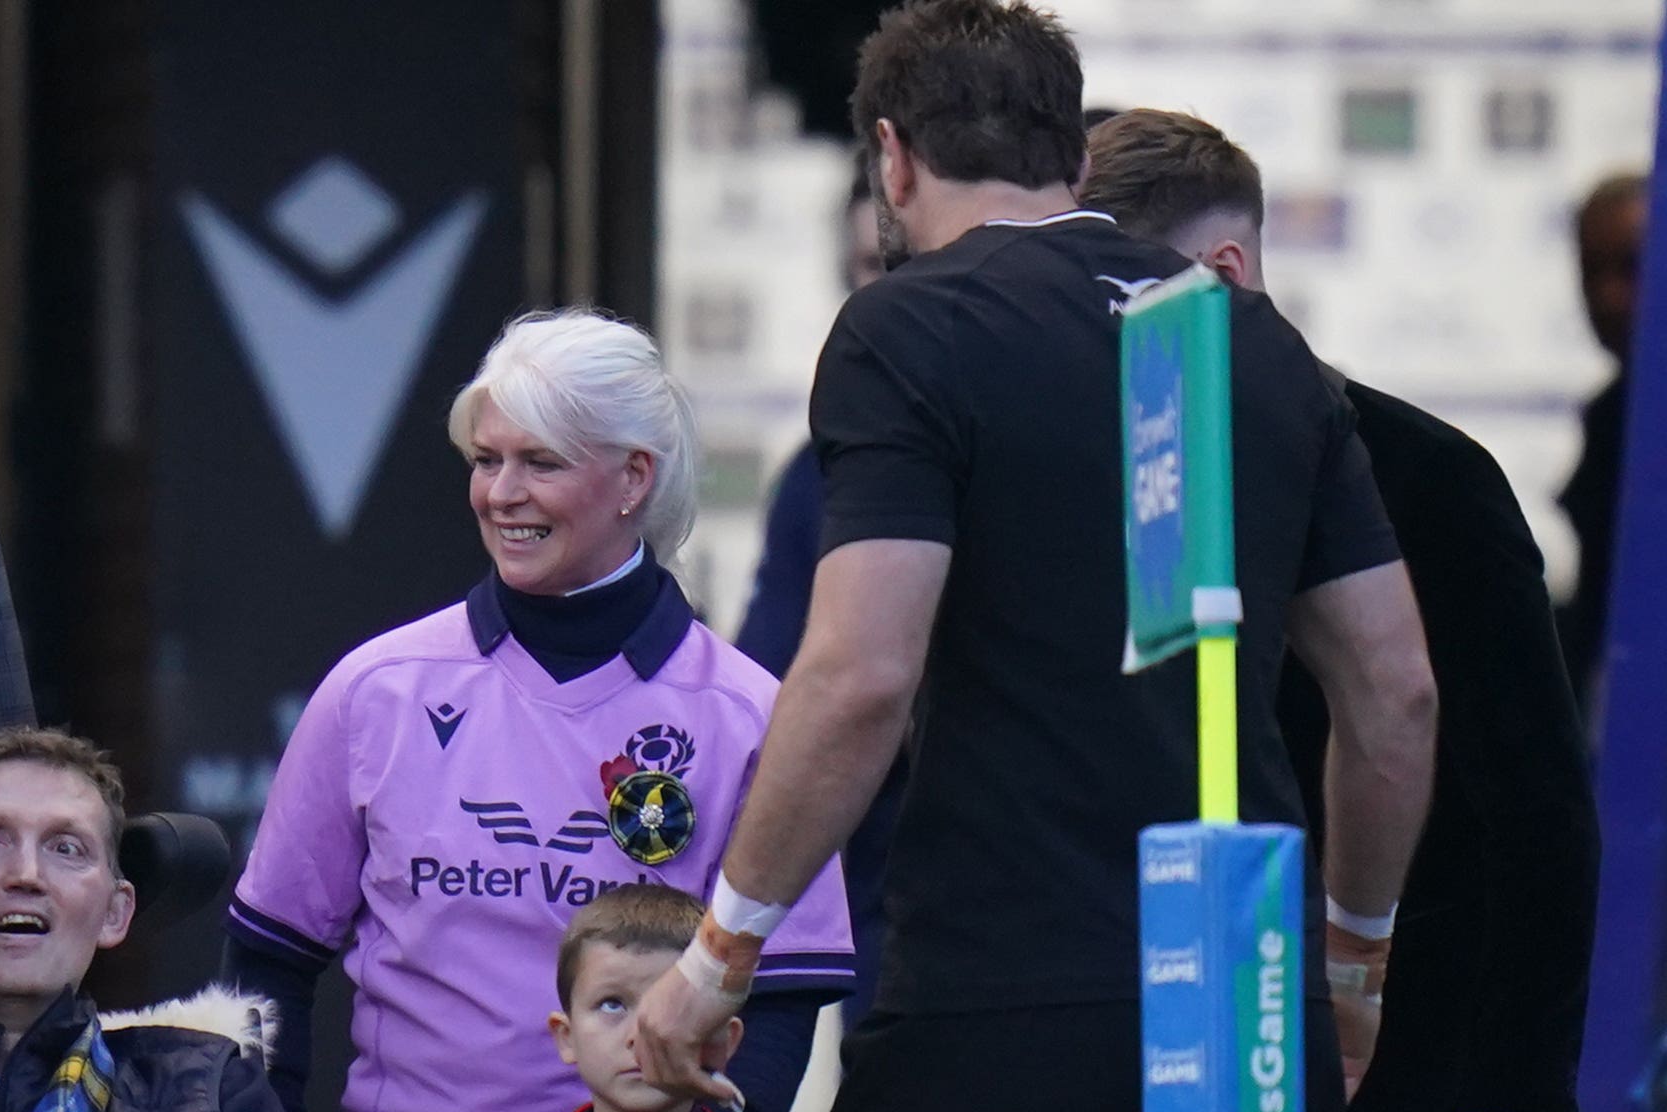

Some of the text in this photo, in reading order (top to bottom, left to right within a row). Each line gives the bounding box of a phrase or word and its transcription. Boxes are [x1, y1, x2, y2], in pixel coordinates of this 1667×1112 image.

[410, 857, 650, 907] Peter Var
[1147, 961, 1197, 985] GAME
[1149, 1062, 1200, 1085] GAME
